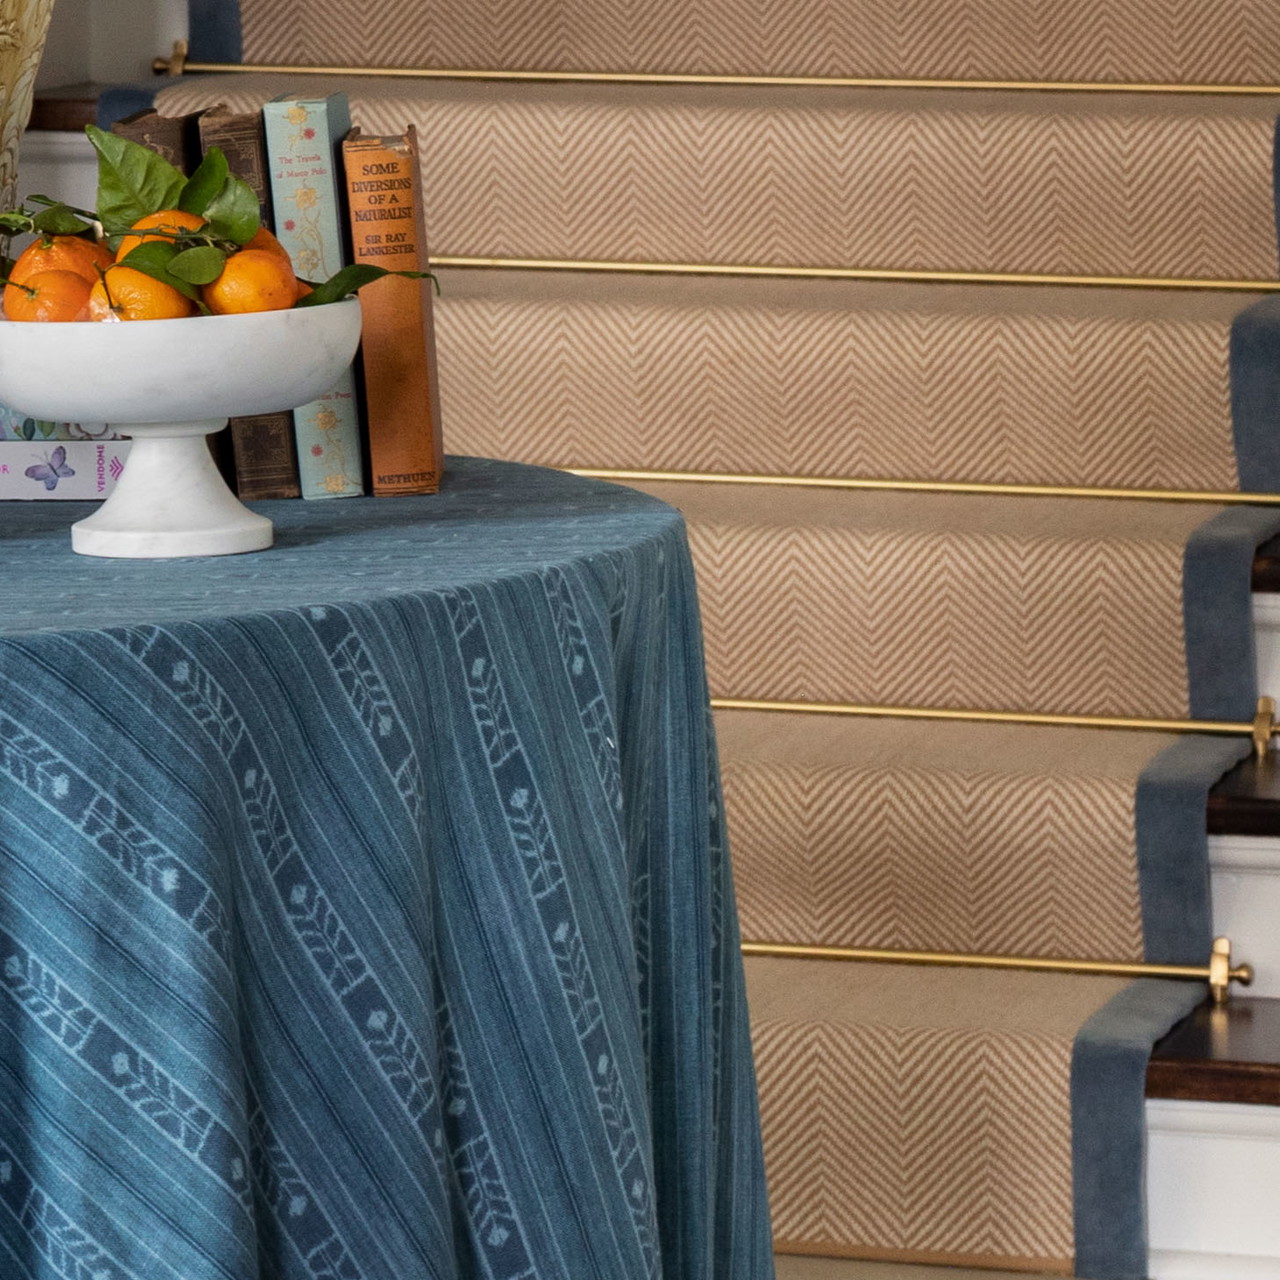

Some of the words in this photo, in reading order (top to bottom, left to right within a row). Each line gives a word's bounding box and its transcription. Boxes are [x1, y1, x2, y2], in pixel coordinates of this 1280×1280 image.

[278, 156, 293, 165] The
[362, 162, 400, 176] SOME
[351, 177, 413, 194] DIVERSIONS
[368, 194, 386, 205] OF
[389, 193, 399, 204] A
[354, 206, 414, 222] NATURALIST
[365, 234, 382, 245] SIR
[386, 232, 407, 243] RAY
[358, 243, 416, 257] LANKESTER
[96, 444, 106, 493] VENDOME
[377, 471, 436, 485] METHUEN
